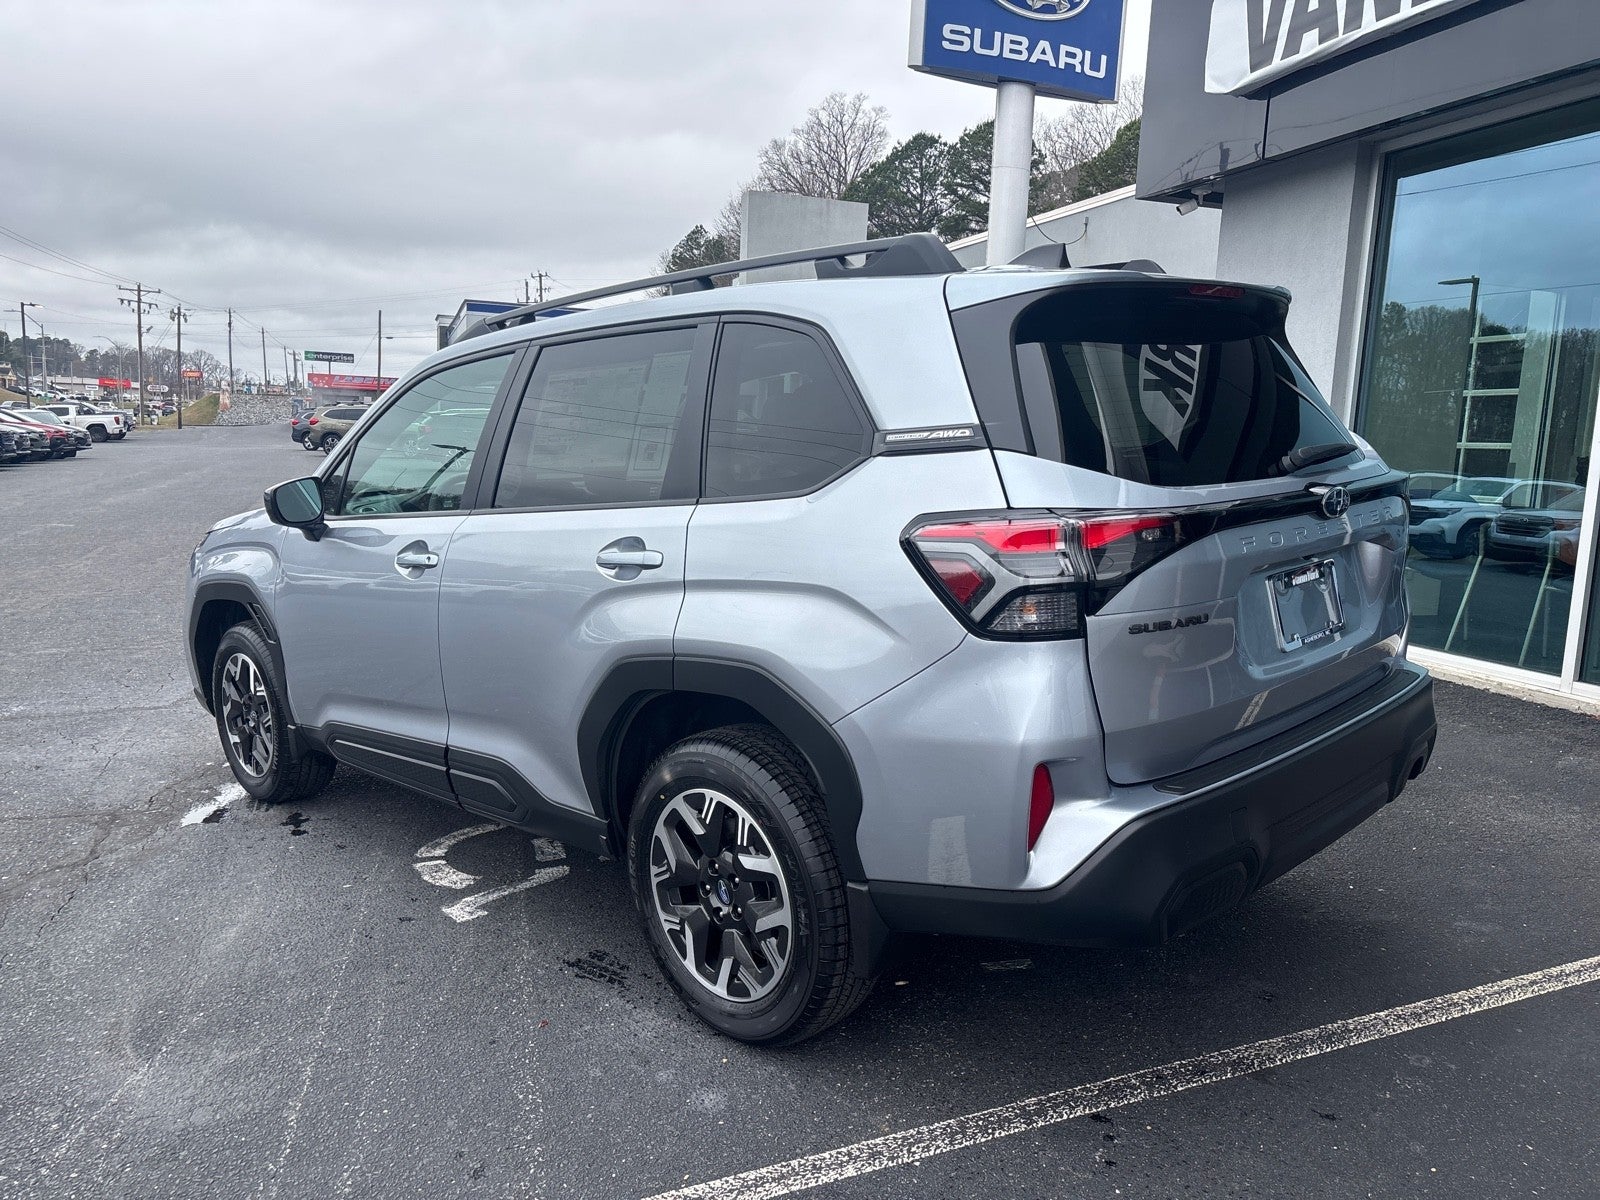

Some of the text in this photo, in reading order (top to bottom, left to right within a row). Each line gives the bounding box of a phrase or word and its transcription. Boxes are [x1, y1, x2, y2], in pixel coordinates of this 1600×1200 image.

[941, 23, 1108, 79] SUBARU
[306, 353, 354, 361] enterprise
[928, 428, 971, 439] AWD
[1240, 506, 1394, 555] FORESTER
[1128, 613, 1209, 635] SUBARU
